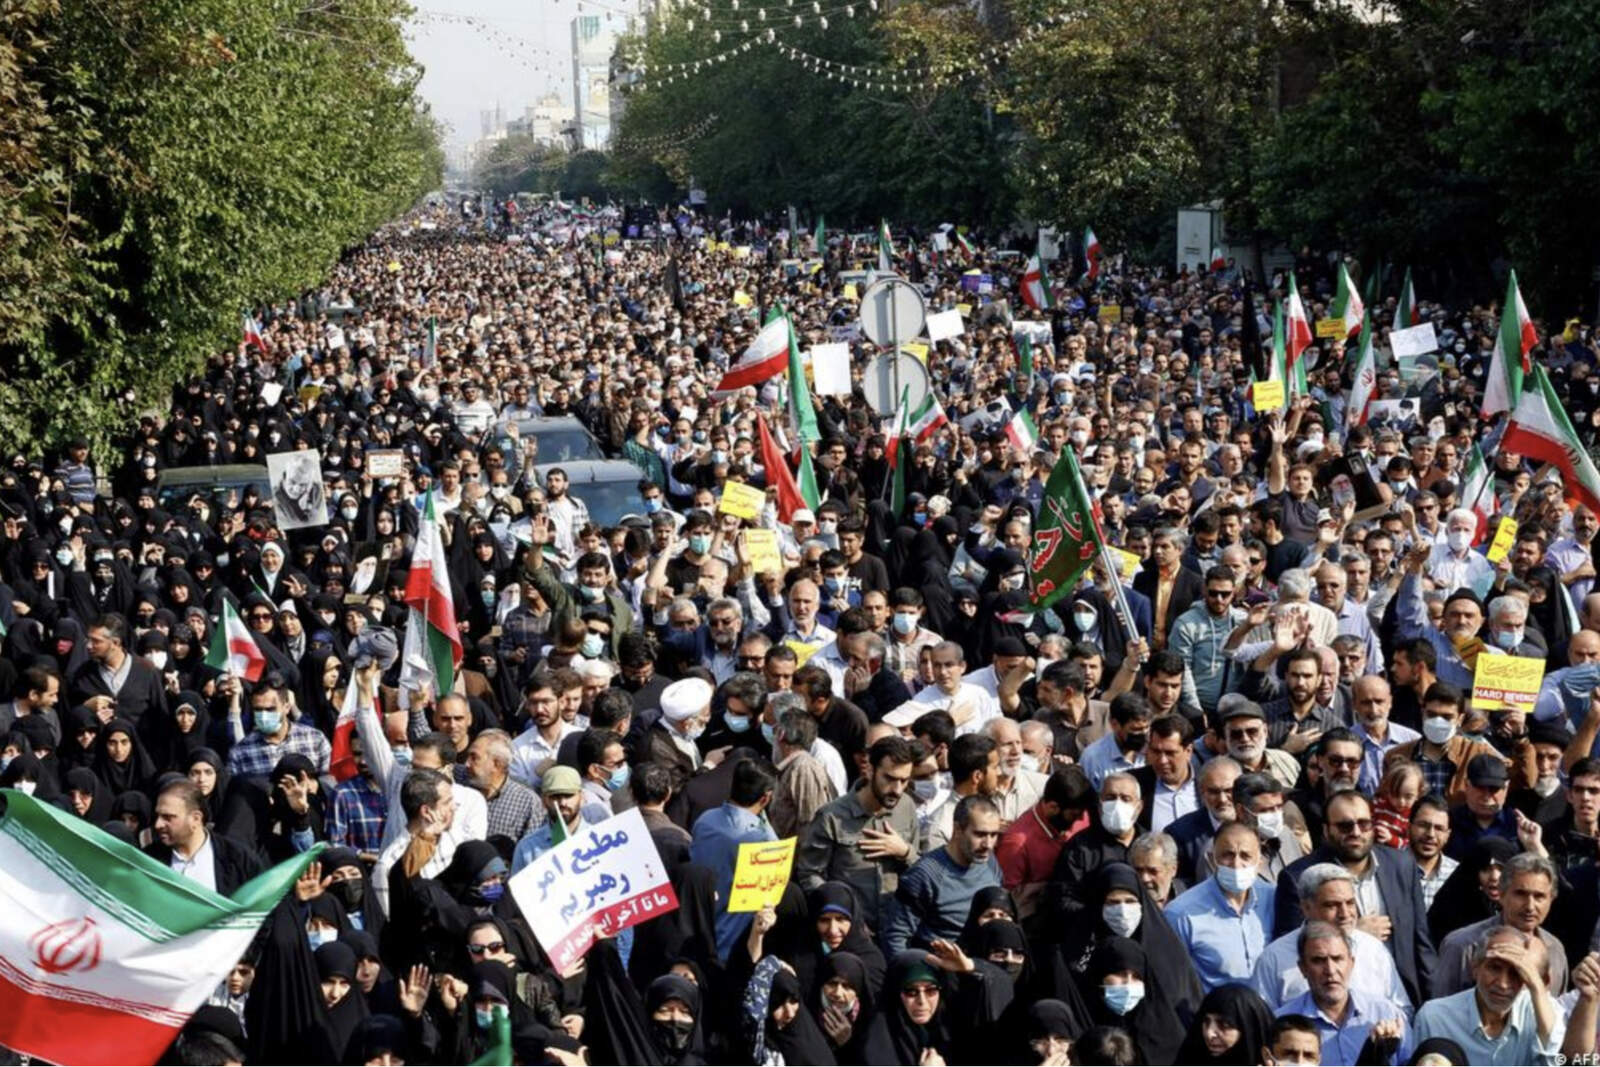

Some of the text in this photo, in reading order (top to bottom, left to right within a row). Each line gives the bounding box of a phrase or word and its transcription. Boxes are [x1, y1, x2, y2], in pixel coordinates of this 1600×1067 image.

[1475, 689, 1503, 700] HARD
[535, 829, 629, 902] مطیع امر
[558, 870, 631, 925] رهبریم
[640, 896, 654, 912] تا
[654, 891, 669, 906] ما
[616, 898, 640, 928] آخر
